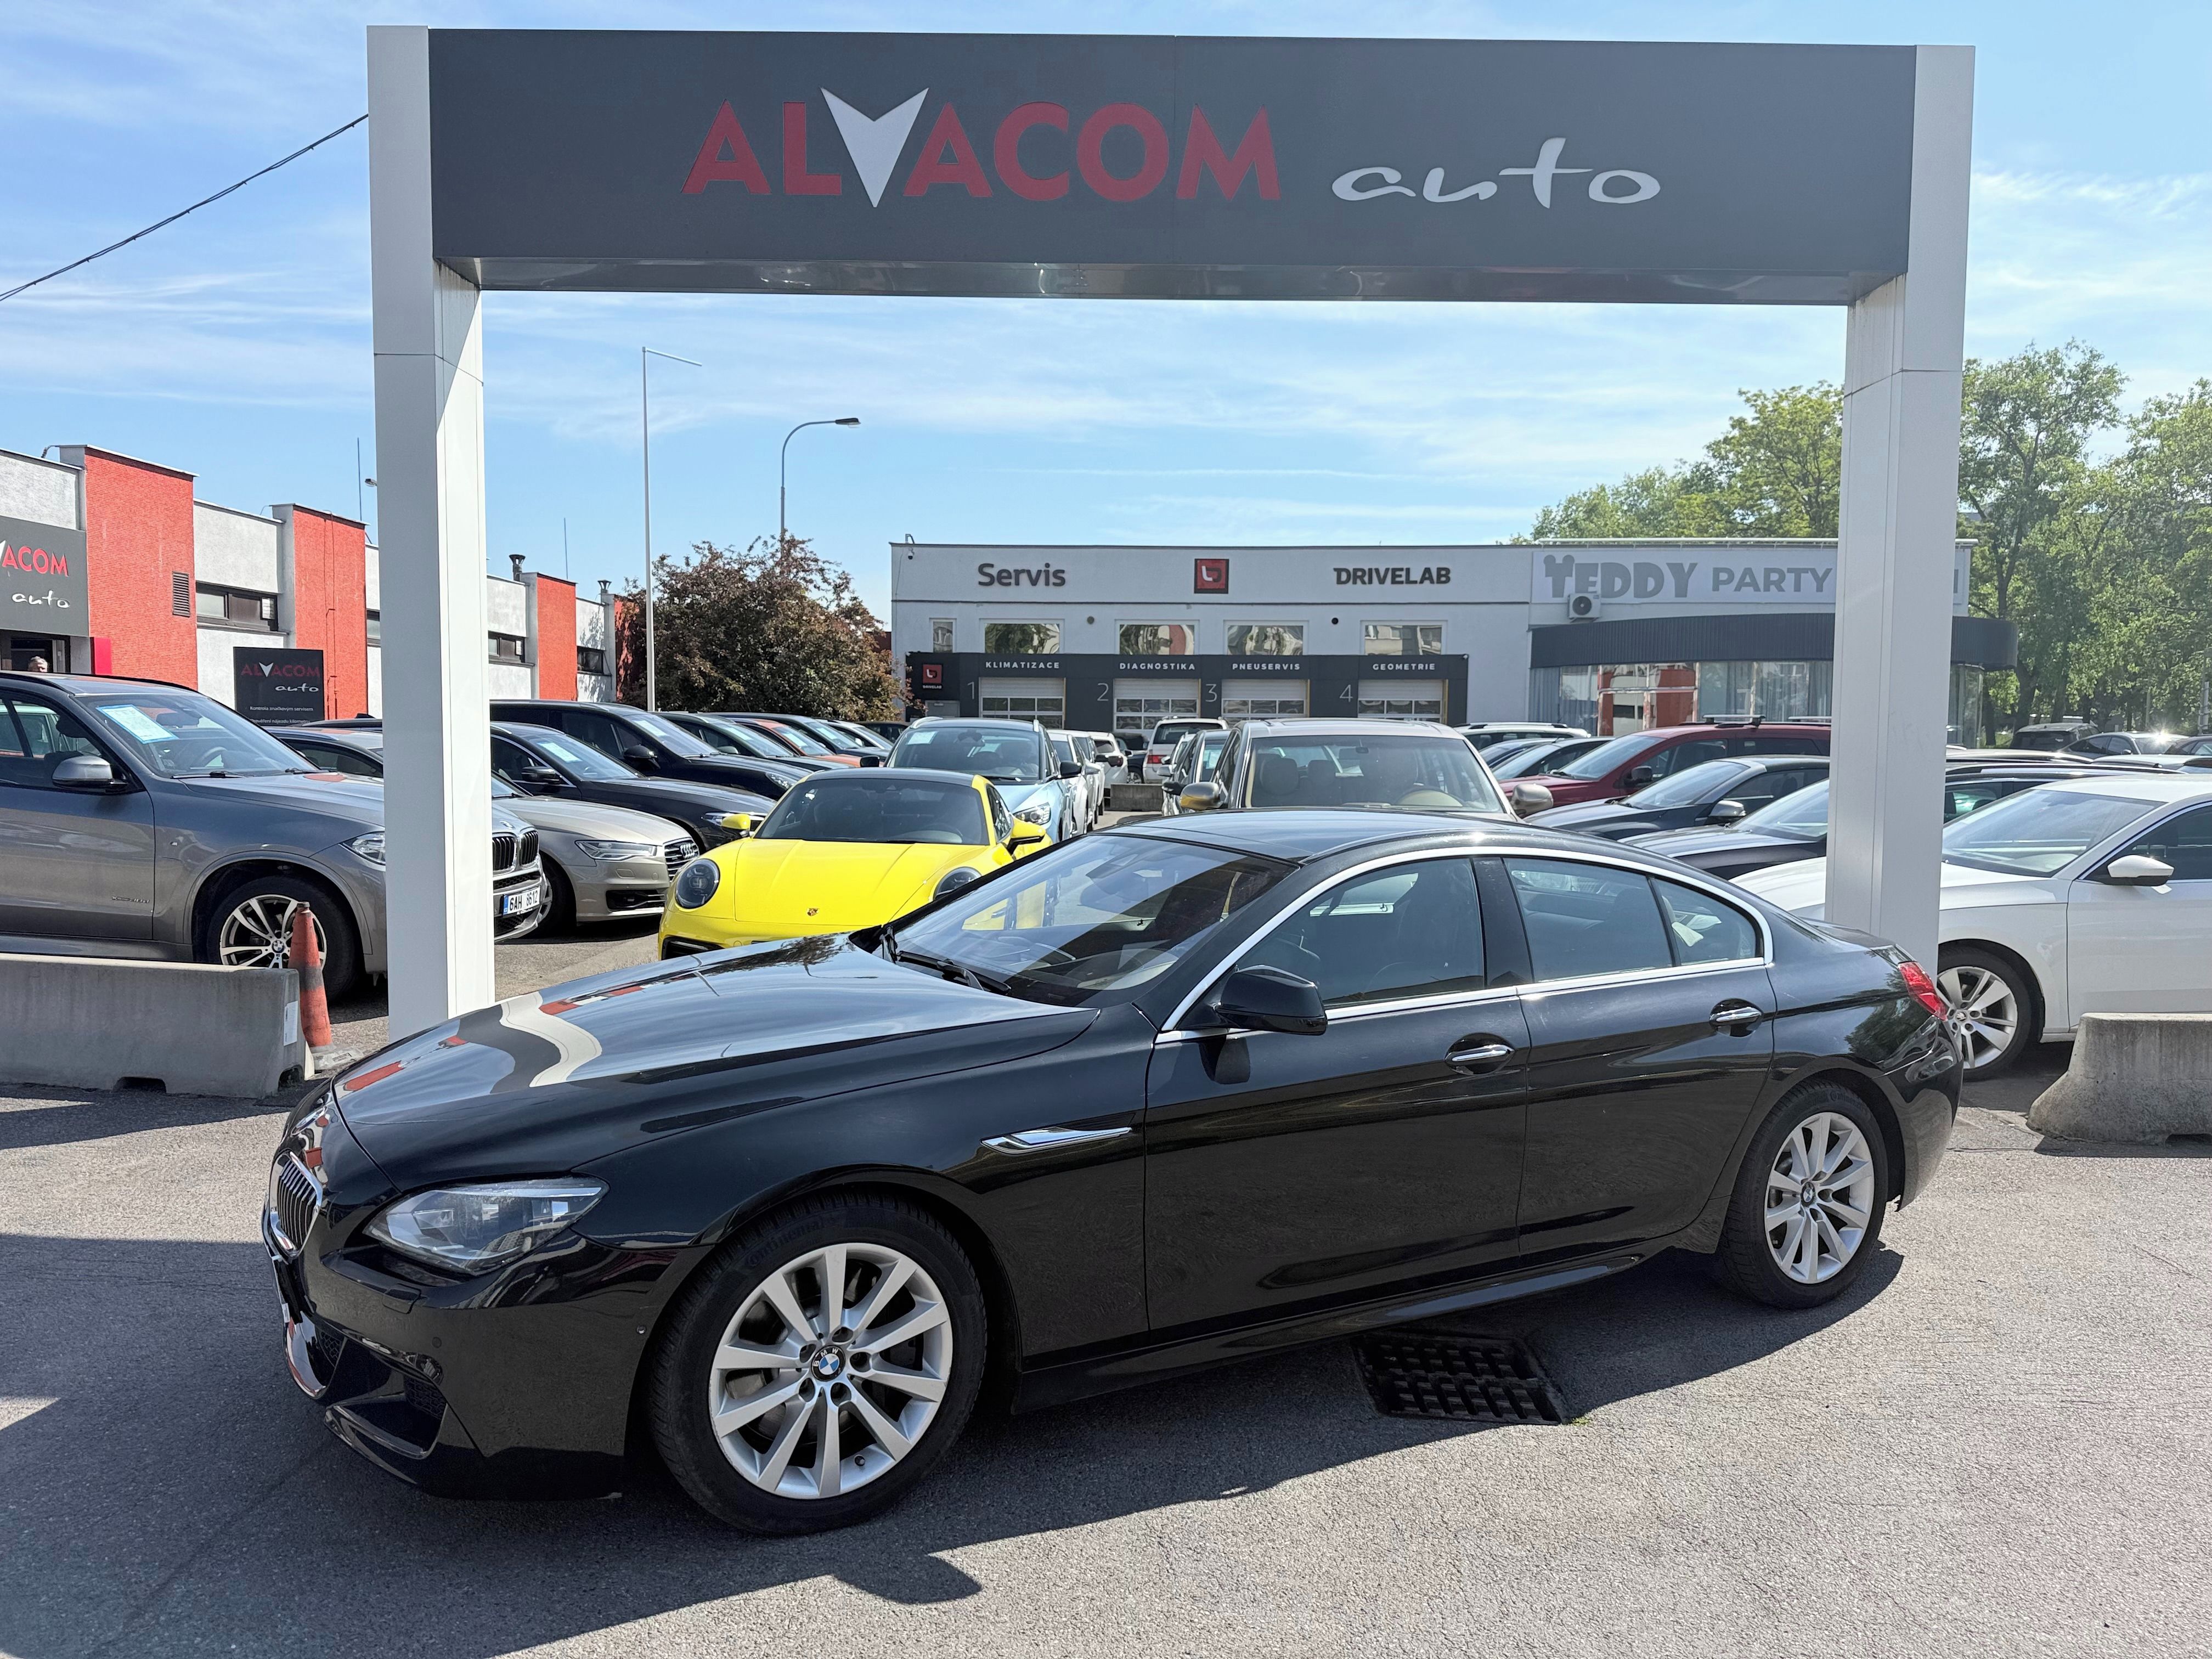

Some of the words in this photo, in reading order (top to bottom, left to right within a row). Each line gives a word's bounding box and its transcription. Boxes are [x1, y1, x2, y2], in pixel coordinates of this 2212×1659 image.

[680, 87, 1282, 208] ALVACOM
[1331, 137, 1661, 208] auto
[978, 562, 1066, 586] Servis
[1333, 567, 1451, 585] DRIVELAB
[1543, 554, 1698, 599] TEDDY
[1712, 567, 1833, 592] PARTY
[12, 590, 70, 608] auto
[241, 662, 320, 678] ALVACOM
[275, 682, 319, 692] auto
[967, 681, 975, 699] 1
[1097, 682, 1109, 701] 2
[1205, 684, 1217, 702] 3
[1339, 684, 1353, 703] 4
[510, 894, 522, 911] 6AH
[812, 1347, 839, 1367] BMW
